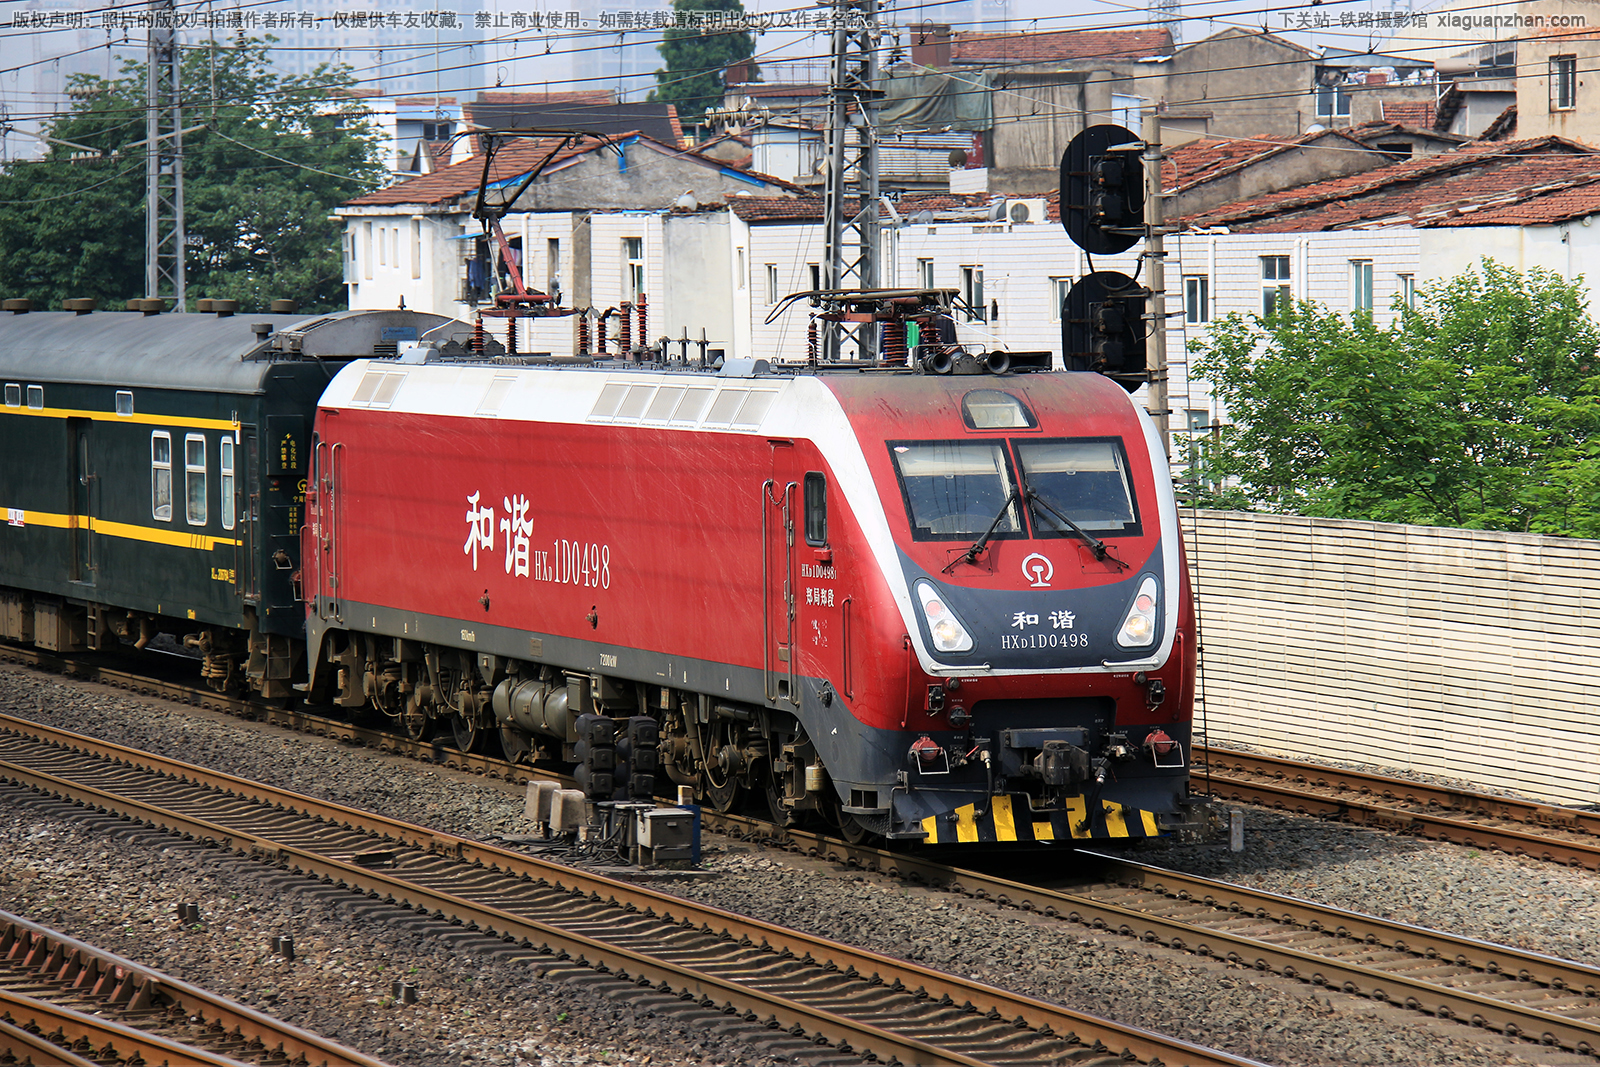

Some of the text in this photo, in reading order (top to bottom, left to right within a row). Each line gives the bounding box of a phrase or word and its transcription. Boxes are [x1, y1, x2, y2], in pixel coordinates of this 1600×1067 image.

[463, 490, 534, 578] 和谐
[534, 540, 610, 590] HXD1D0498
[1001, 633, 1089, 650] HXD1D0498
